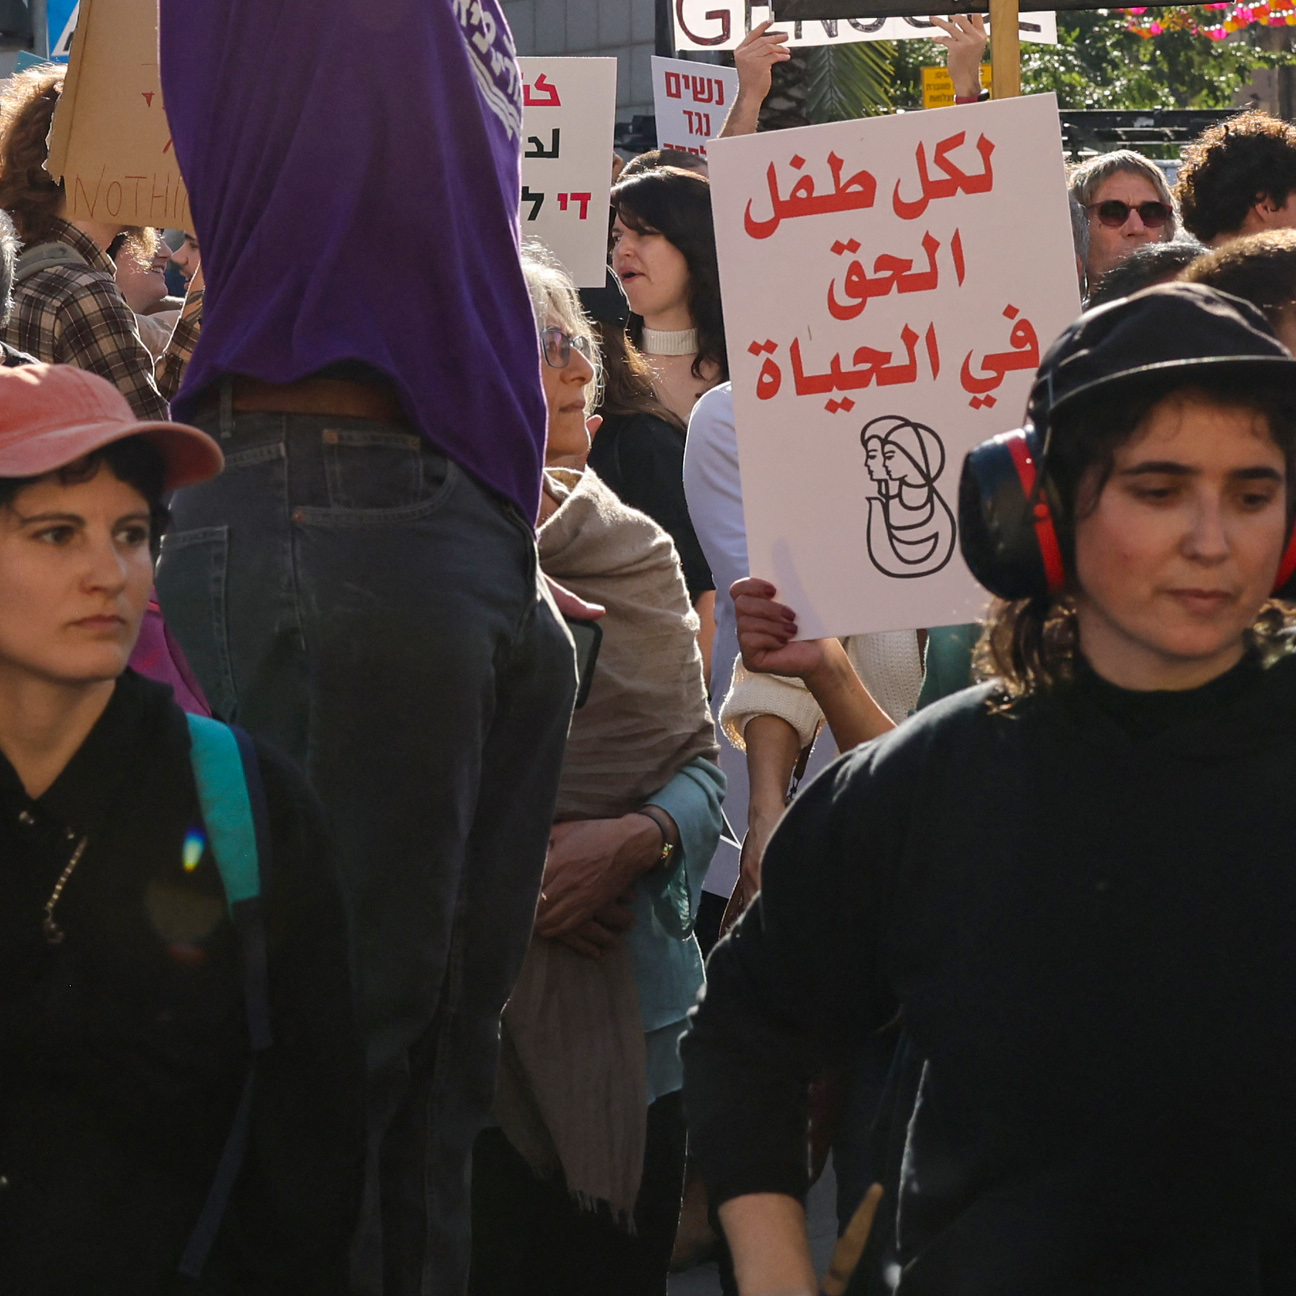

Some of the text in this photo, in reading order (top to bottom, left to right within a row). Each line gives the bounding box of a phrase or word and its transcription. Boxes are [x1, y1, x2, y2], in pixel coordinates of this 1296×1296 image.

[664, 71, 725, 106] נשים
[682, 109, 712, 137] נגד
[557, 192, 592, 220] די
[743, 130, 996, 240] لكل طفل
[826, 227, 967, 321] الحق
[746, 304, 1041, 415] في الحياة
